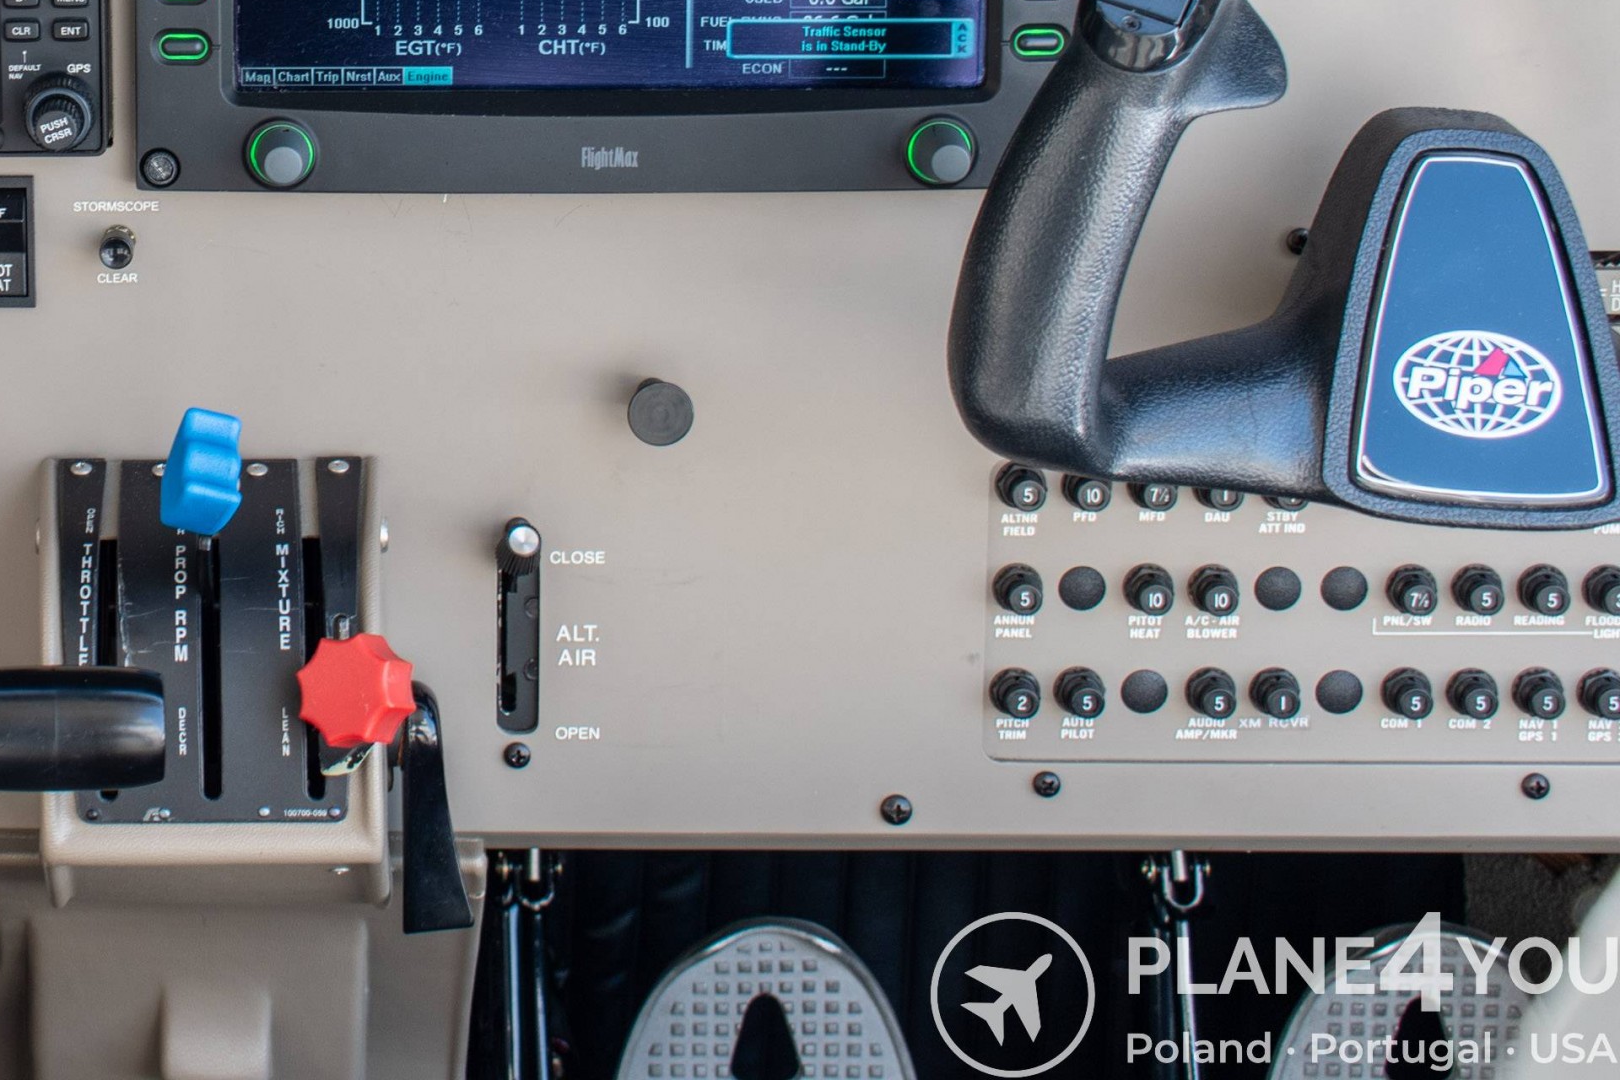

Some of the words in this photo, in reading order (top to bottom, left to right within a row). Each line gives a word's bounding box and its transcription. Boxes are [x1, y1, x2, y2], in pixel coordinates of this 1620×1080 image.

[802, 27, 840, 36] Traffic
[844, 27, 887, 36] Sensor
[802, 42, 813, 51] is
[816, 42, 828, 51] in
[831, 41, 886, 53] Stand-By
[408, 70, 448, 83] Engine
[73, 202, 158, 212] STORMSCOPE
[97, 273, 137, 283] CLEAR
[1407, 366, 1554, 409] Piper
[1001, 514, 1038, 523] ALTNR
[1073, 512, 1096, 521] PFD
[1139, 512, 1165, 521] MFD
[1004, 527, 1035, 536] FIELD
[550, 551, 605, 564] CLOSE
[276, 544, 290, 650] MIXTURE
[1456, 616, 1491, 626] RADIO
[1514, 616, 1564, 625] READING
[556, 625, 600, 642] ALT.
[996, 629, 1032, 638] PANEL
[1187, 629, 1236, 638] BLOWER
[558, 649, 597, 666] AIR
[996, 718, 1029, 728] PITCH
[1381, 719, 1410, 728] COM
[1417, 719, 1421, 728] 1
[179, 708, 187, 755] DECR
[282, 708, 290, 756] LEAN
[555, 727, 600, 739] OPEN
[998, 730, 1026, 740] TRIM
[1519, 732, 1543, 741] GPS
[1552, 732, 1556, 741] 1
